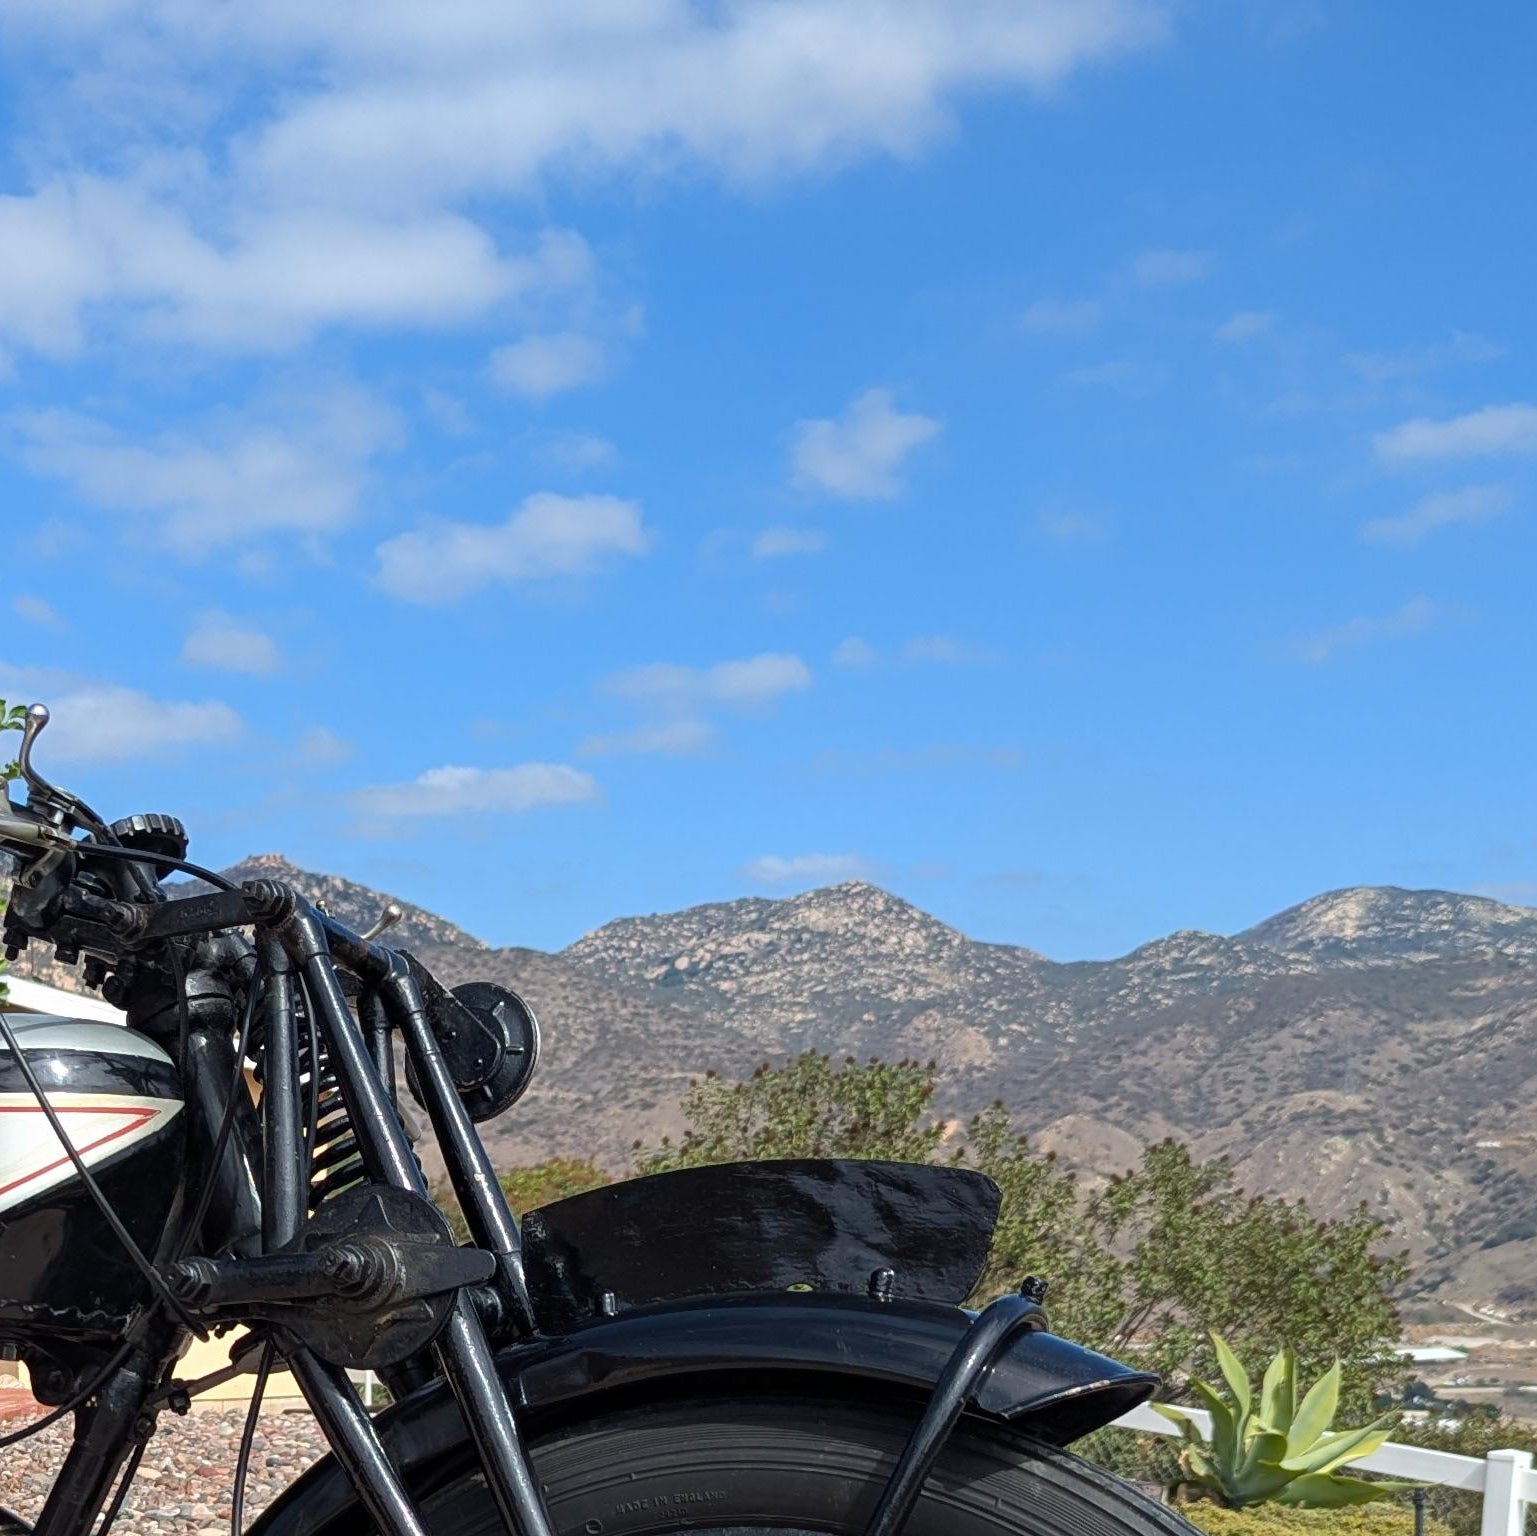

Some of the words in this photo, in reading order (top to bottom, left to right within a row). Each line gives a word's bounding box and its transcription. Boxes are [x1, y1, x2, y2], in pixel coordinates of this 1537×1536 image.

[616, 1499, 649, 1513] MADE
[654, 1495, 668, 1507] IN
[673, 1490, 726, 1504] ENGLAND
